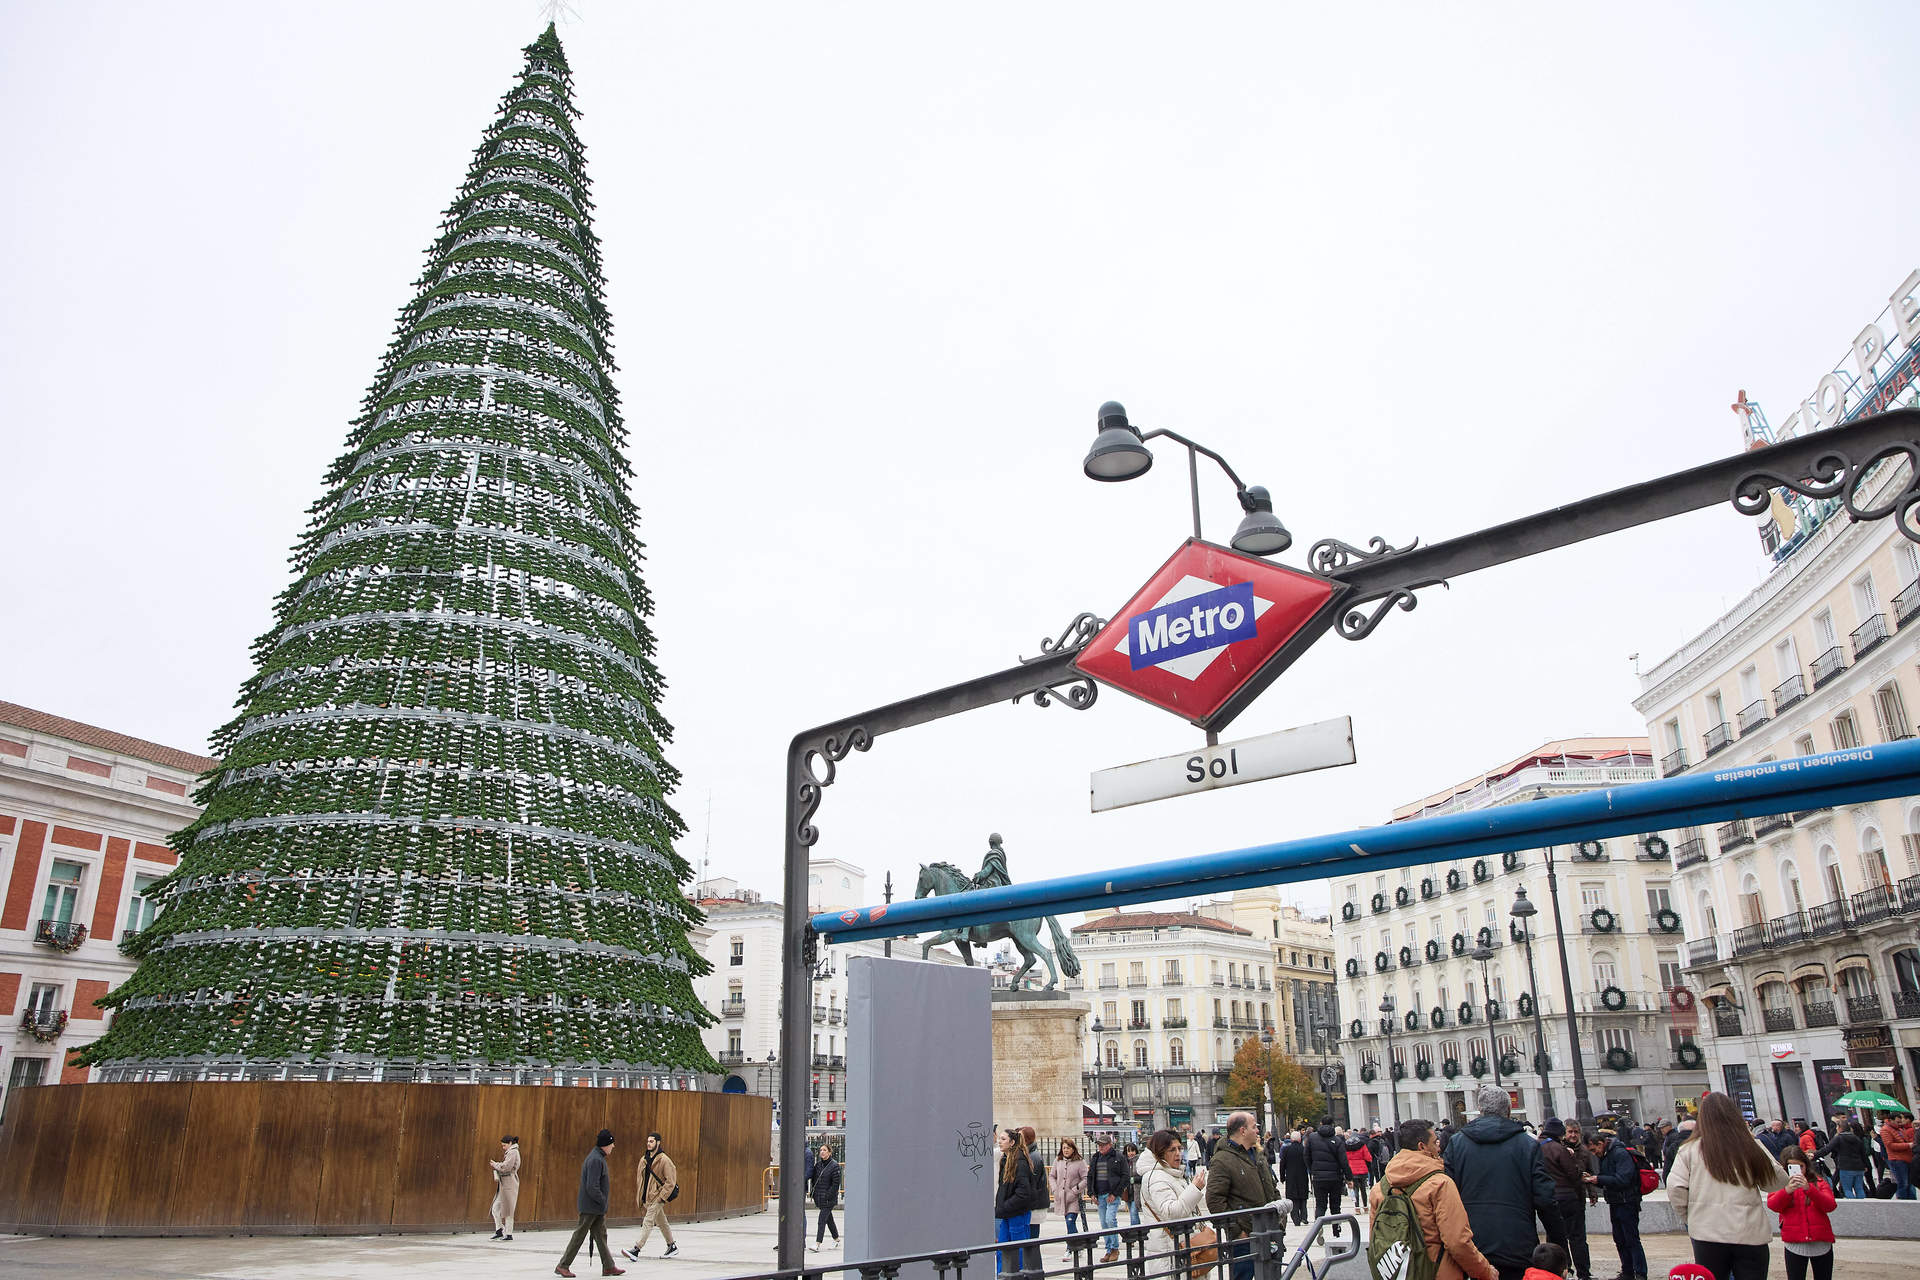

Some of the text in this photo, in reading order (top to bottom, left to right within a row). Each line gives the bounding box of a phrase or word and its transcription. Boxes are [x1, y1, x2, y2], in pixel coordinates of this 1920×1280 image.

[1138, 601, 1245, 655] Metro
[1186, 748, 1239, 783] Sol
[1714, 750, 1874, 782] Disculpen las molestias
[1377, 1241, 1408, 1280] NIKE
